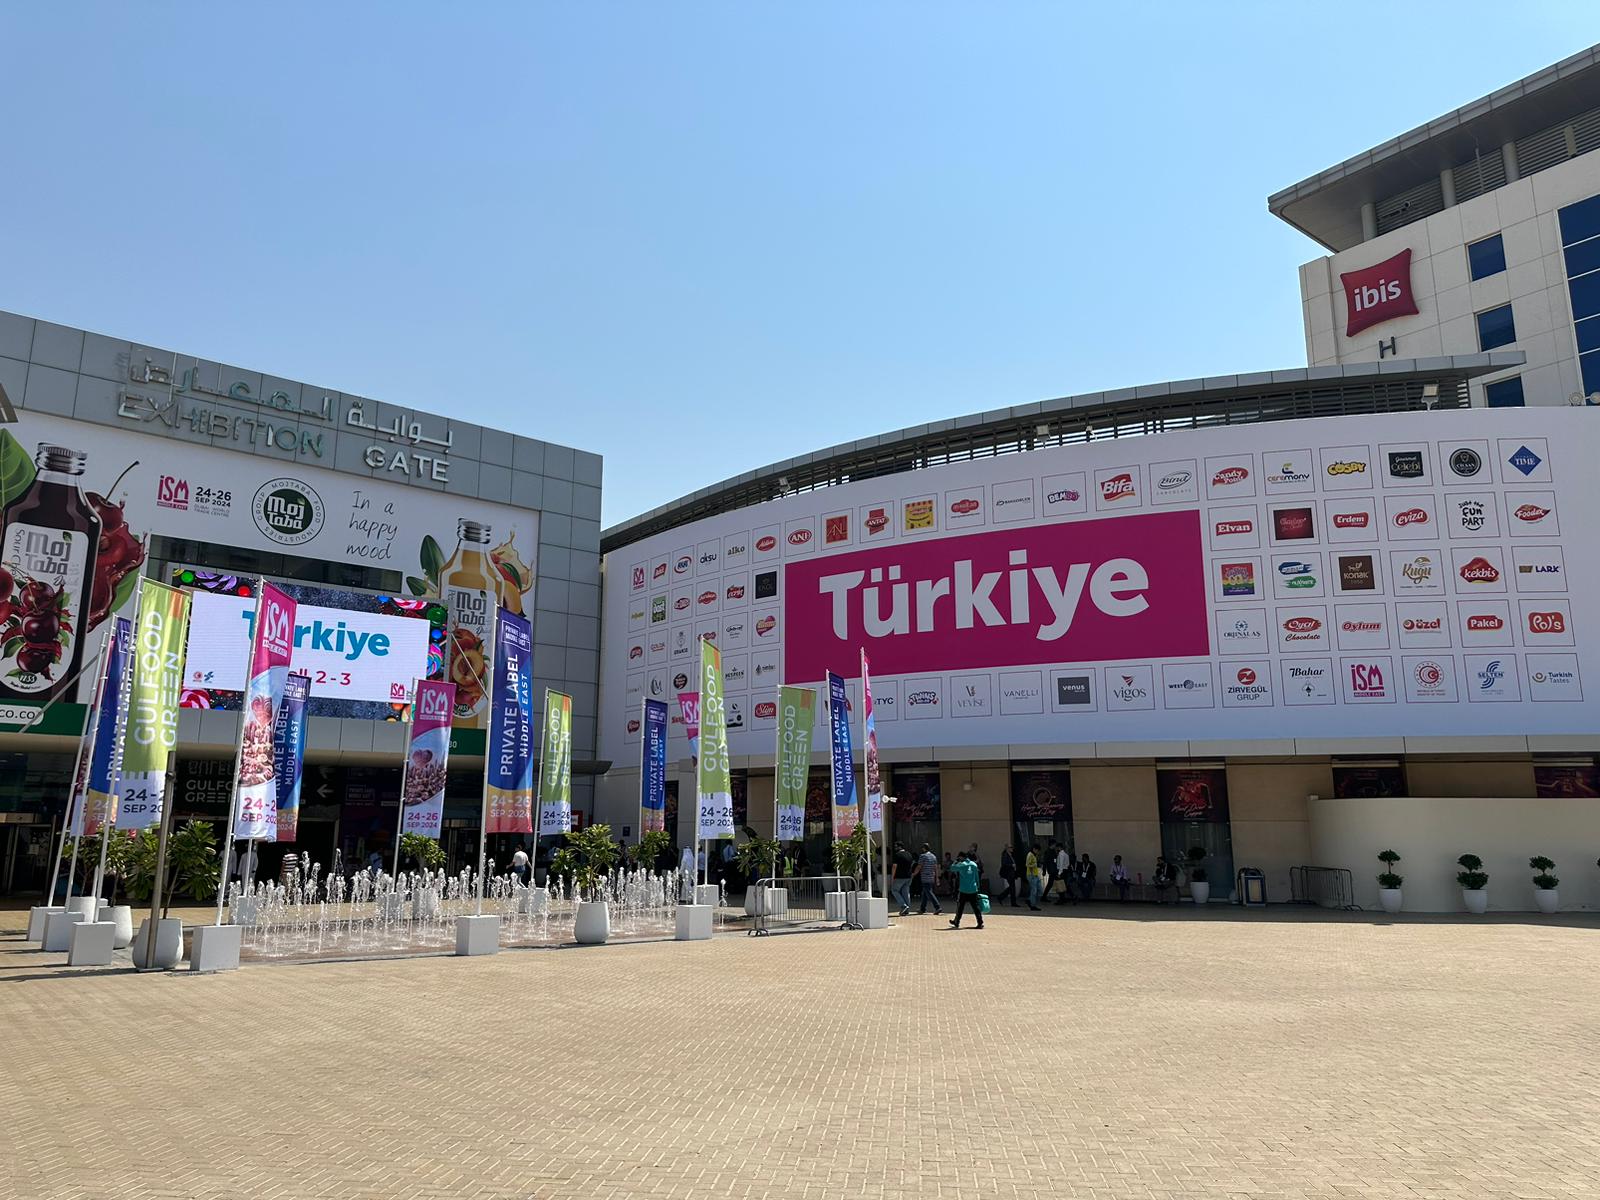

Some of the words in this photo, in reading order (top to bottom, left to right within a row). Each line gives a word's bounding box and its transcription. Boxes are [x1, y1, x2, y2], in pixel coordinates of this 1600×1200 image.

[1353, 277, 1402, 312] ibis
[118, 391, 323, 458] EXHIBITION
[363, 444, 451, 483] GATE
[1515, 457, 1536, 466] TIME
[1214, 470, 1243, 482] Candy
[195, 486, 232, 501] 24-26
[1103, 479, 1134, 494] Bifa
[195, 496, 211, 504] SEP
[211, 499, 231, 508] 2024
[352, 490, 369, 509] In
[1337, 516, 1365, 525] Erdem
[1398, 510, 1424, 525] eviza
[1461, 517, 1485, 526] PART
[349, 512, 398, 541] happy
[1218, 521, 1251, 534] Elvan
[346, 542, 391, 560] mood
[1535, 565, 1560, 573] LARK
[818, 548, 1151, 642] Türkiye
[1470, 618, 1499, 629] Pakel
[242, 609, 390, 661] Trkiye
[1285, 633, 1321, 642] Chocolate
[134, 610, 163, 746] GULFOOD
[505, 653, 519, 701] LABEL
[520, 674, 529, 705] EAST
[1062, 683, 1086, 691] venus
[159, 651, 181, 747] GREEN
[1236, 693, 1260, 701] GRUP
[703, 664, 719, 773] GULFOOD
[833, 706, 841, 744] LABEL
[290, 719, 299, 746] EAST
[519, 708, 529, 758] MIDDLE
[499, 706, 518, 776] PRIVATE
[650, 726, 659, 760] LABEL
[284, 746, 297, 785] MIDDLE
[832, 745, 844, 797] PRIVATE
[843, 746, 852, 784] MIDDLE
[186, 779, 234, 791] GULFO
[649, 760, 659, 802] PRIVATE
[124, 787, 166, 802] 24-2
[123, 804, 147, 814] SEP
[407, 812, 438, 821] 24-26
[241, 813, 264, 822] SEP
[407, 821, 420, 829] SEP
[421, 821, 438, 829] 2024
[700, 818, 715, 826] SEP
